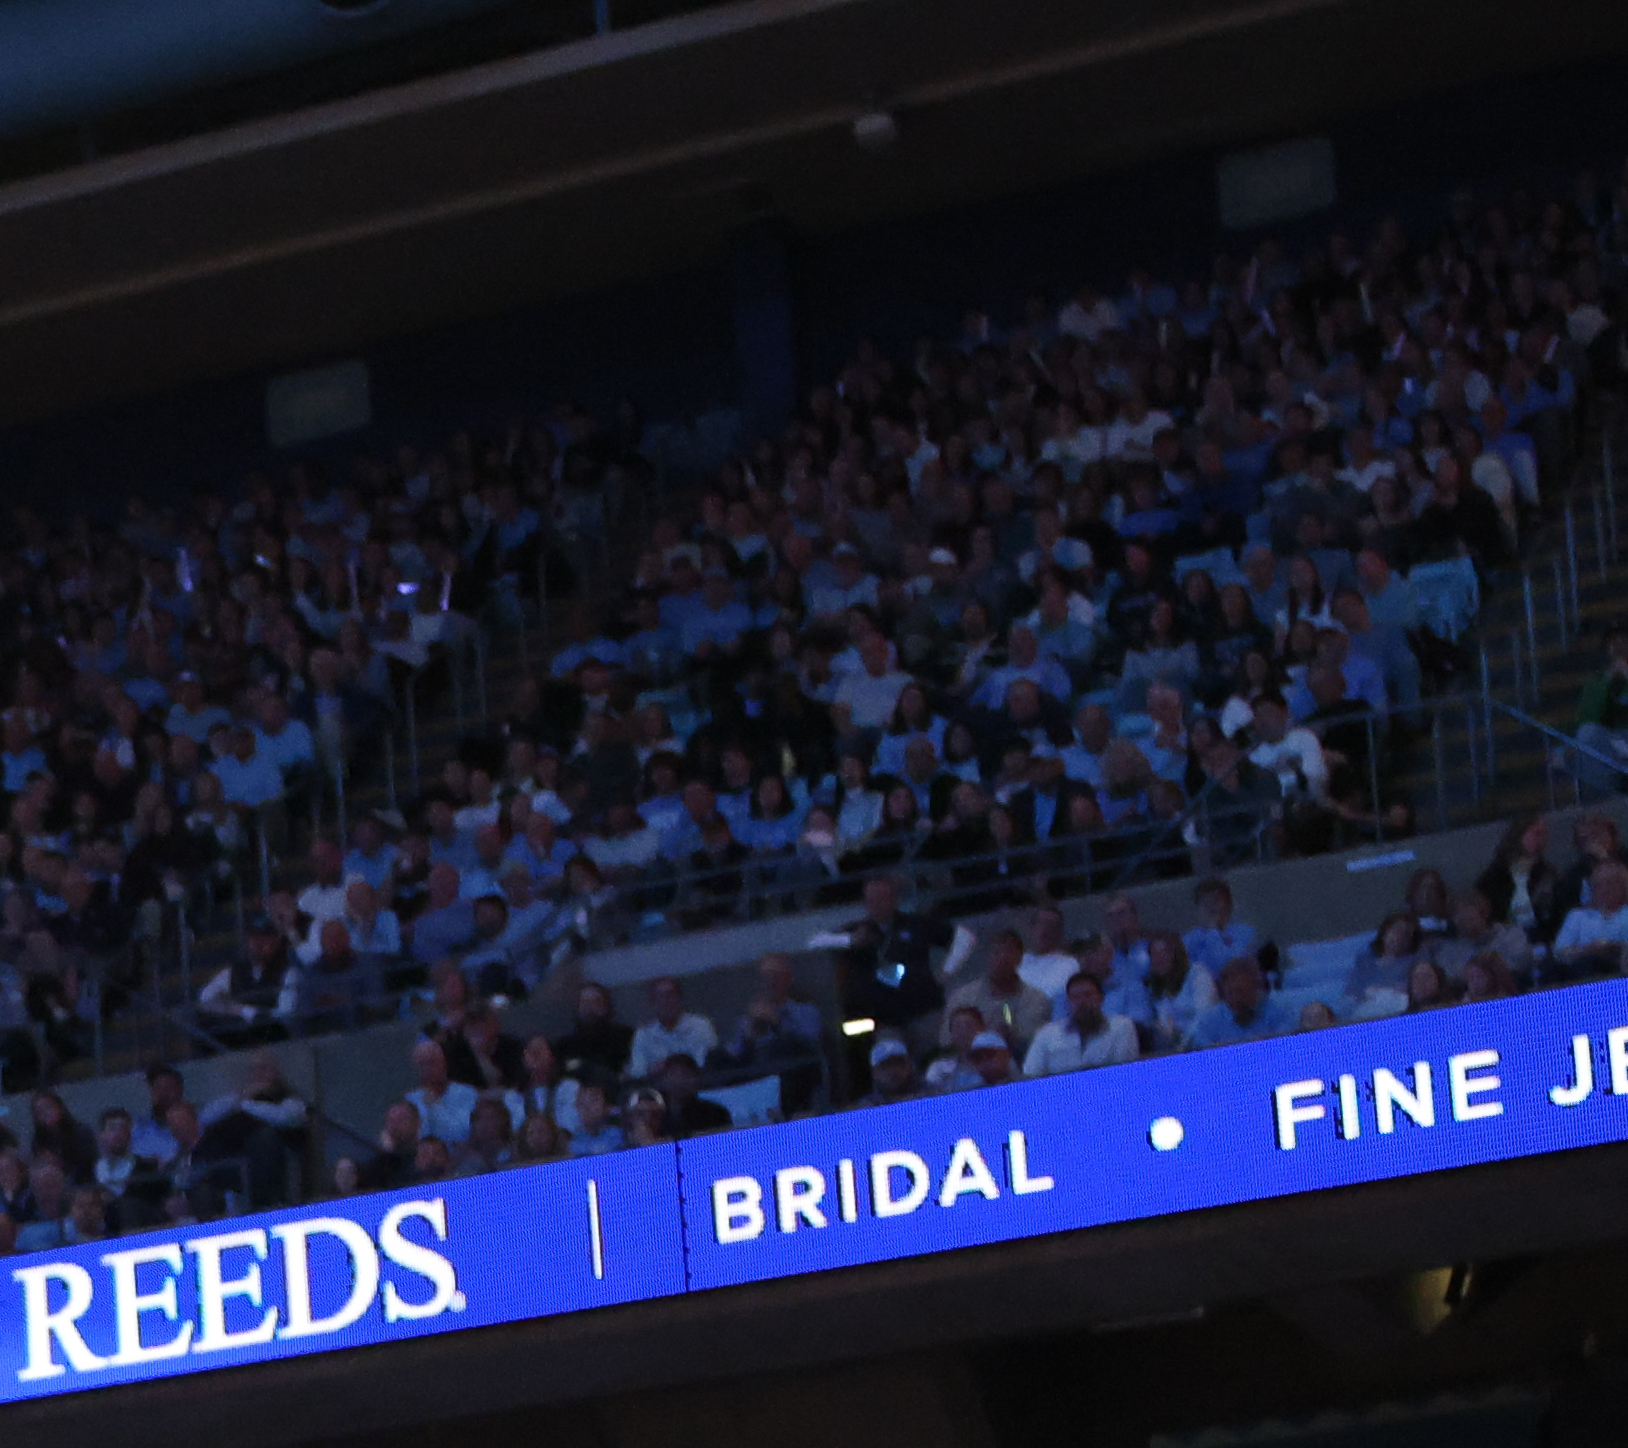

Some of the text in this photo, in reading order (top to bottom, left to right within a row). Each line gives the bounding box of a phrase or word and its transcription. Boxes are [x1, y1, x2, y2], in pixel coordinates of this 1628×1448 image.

[712, 1130, 1054, 1245] BRIDAL
[1275, 1049, 1504, 1151] FINE
[14, 1197, 460, 1381] REEDS
